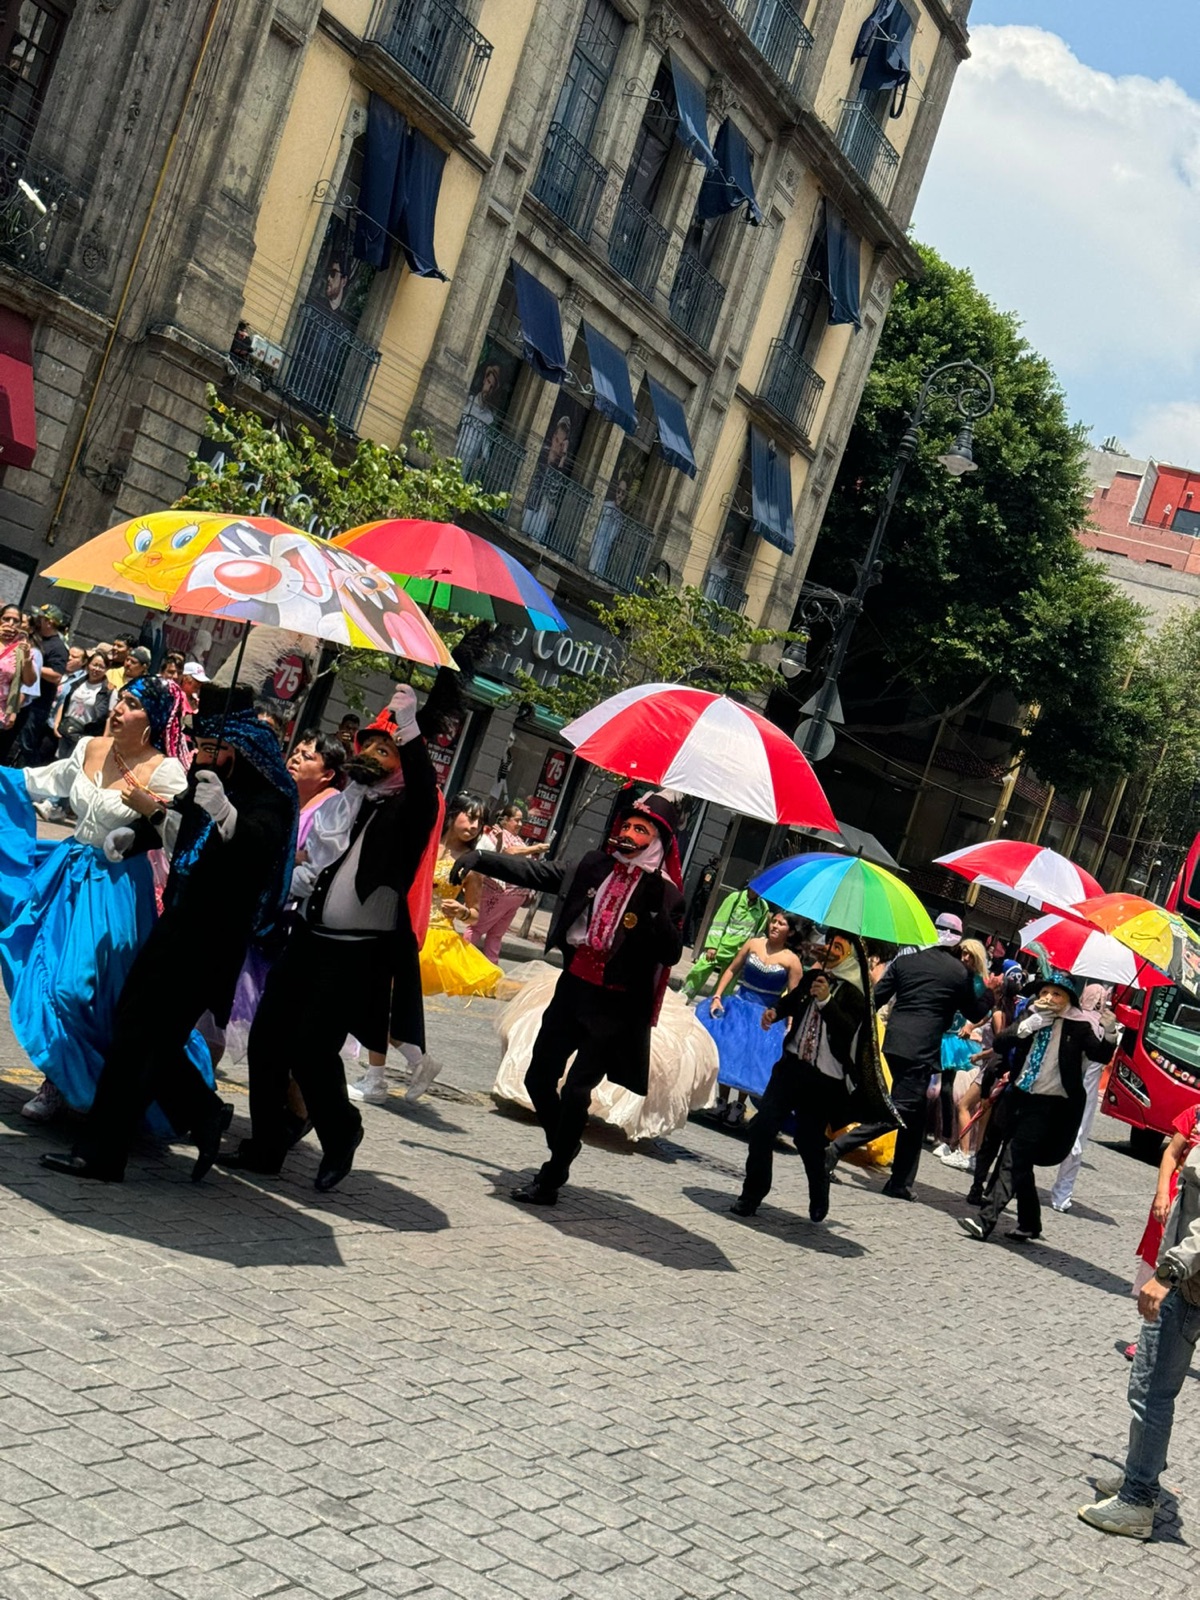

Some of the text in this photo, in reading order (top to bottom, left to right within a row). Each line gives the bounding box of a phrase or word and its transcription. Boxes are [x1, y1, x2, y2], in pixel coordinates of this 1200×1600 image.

[533, 630, 613, 676] Conti
[276, 663, 303, 692] 75
[548, 759, 565, 781] 75
